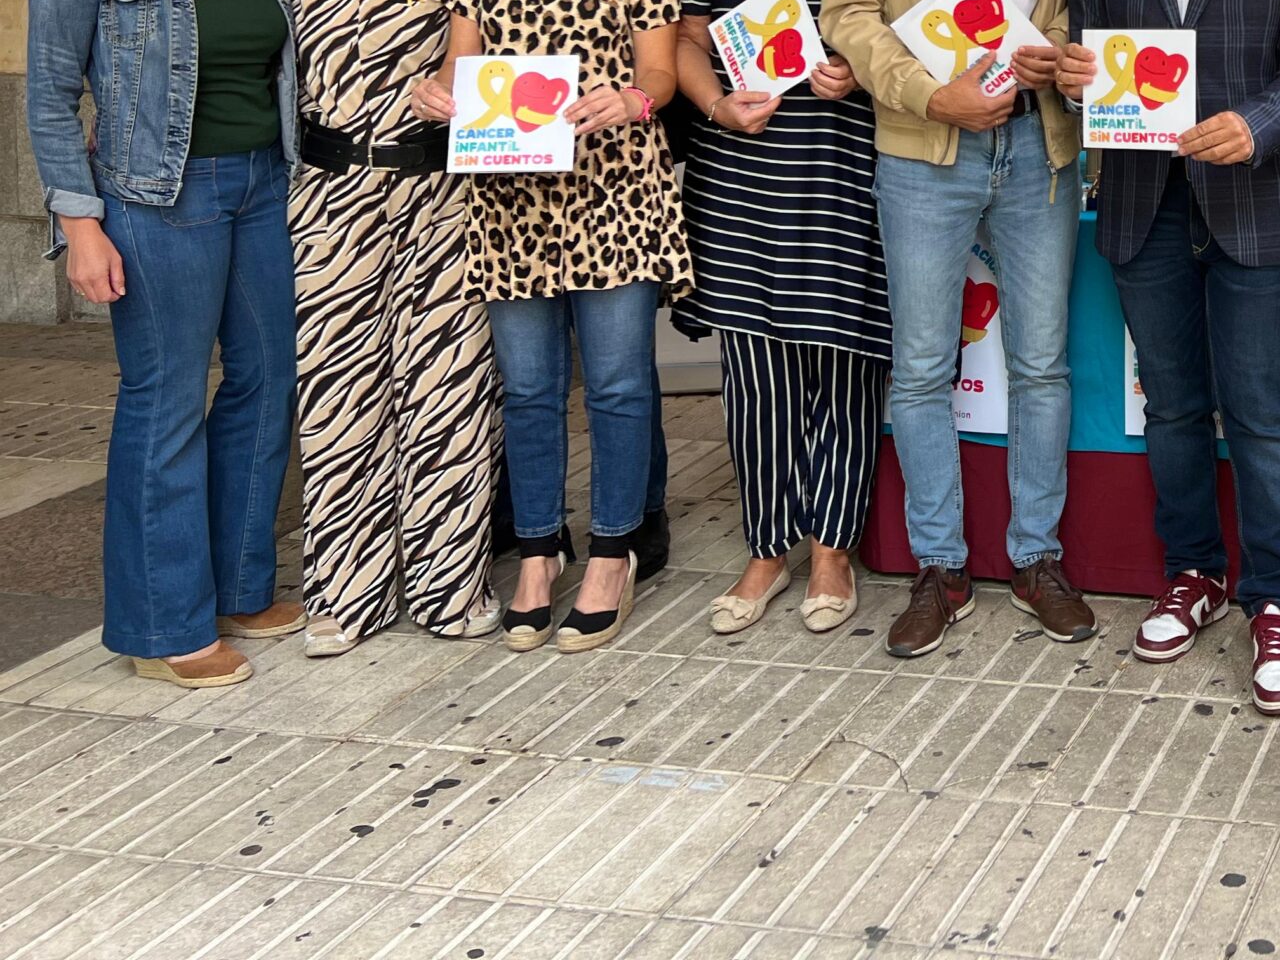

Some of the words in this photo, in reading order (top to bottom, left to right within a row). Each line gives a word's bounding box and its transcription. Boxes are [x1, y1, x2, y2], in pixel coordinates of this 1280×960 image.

[724, 46, 747, 91] CUENTO
[985, 67, 1014, 94] CUEN
[1114, 132, 1178, 143] CUENTOS
[483, 154, 553, 165] CUENTOS
